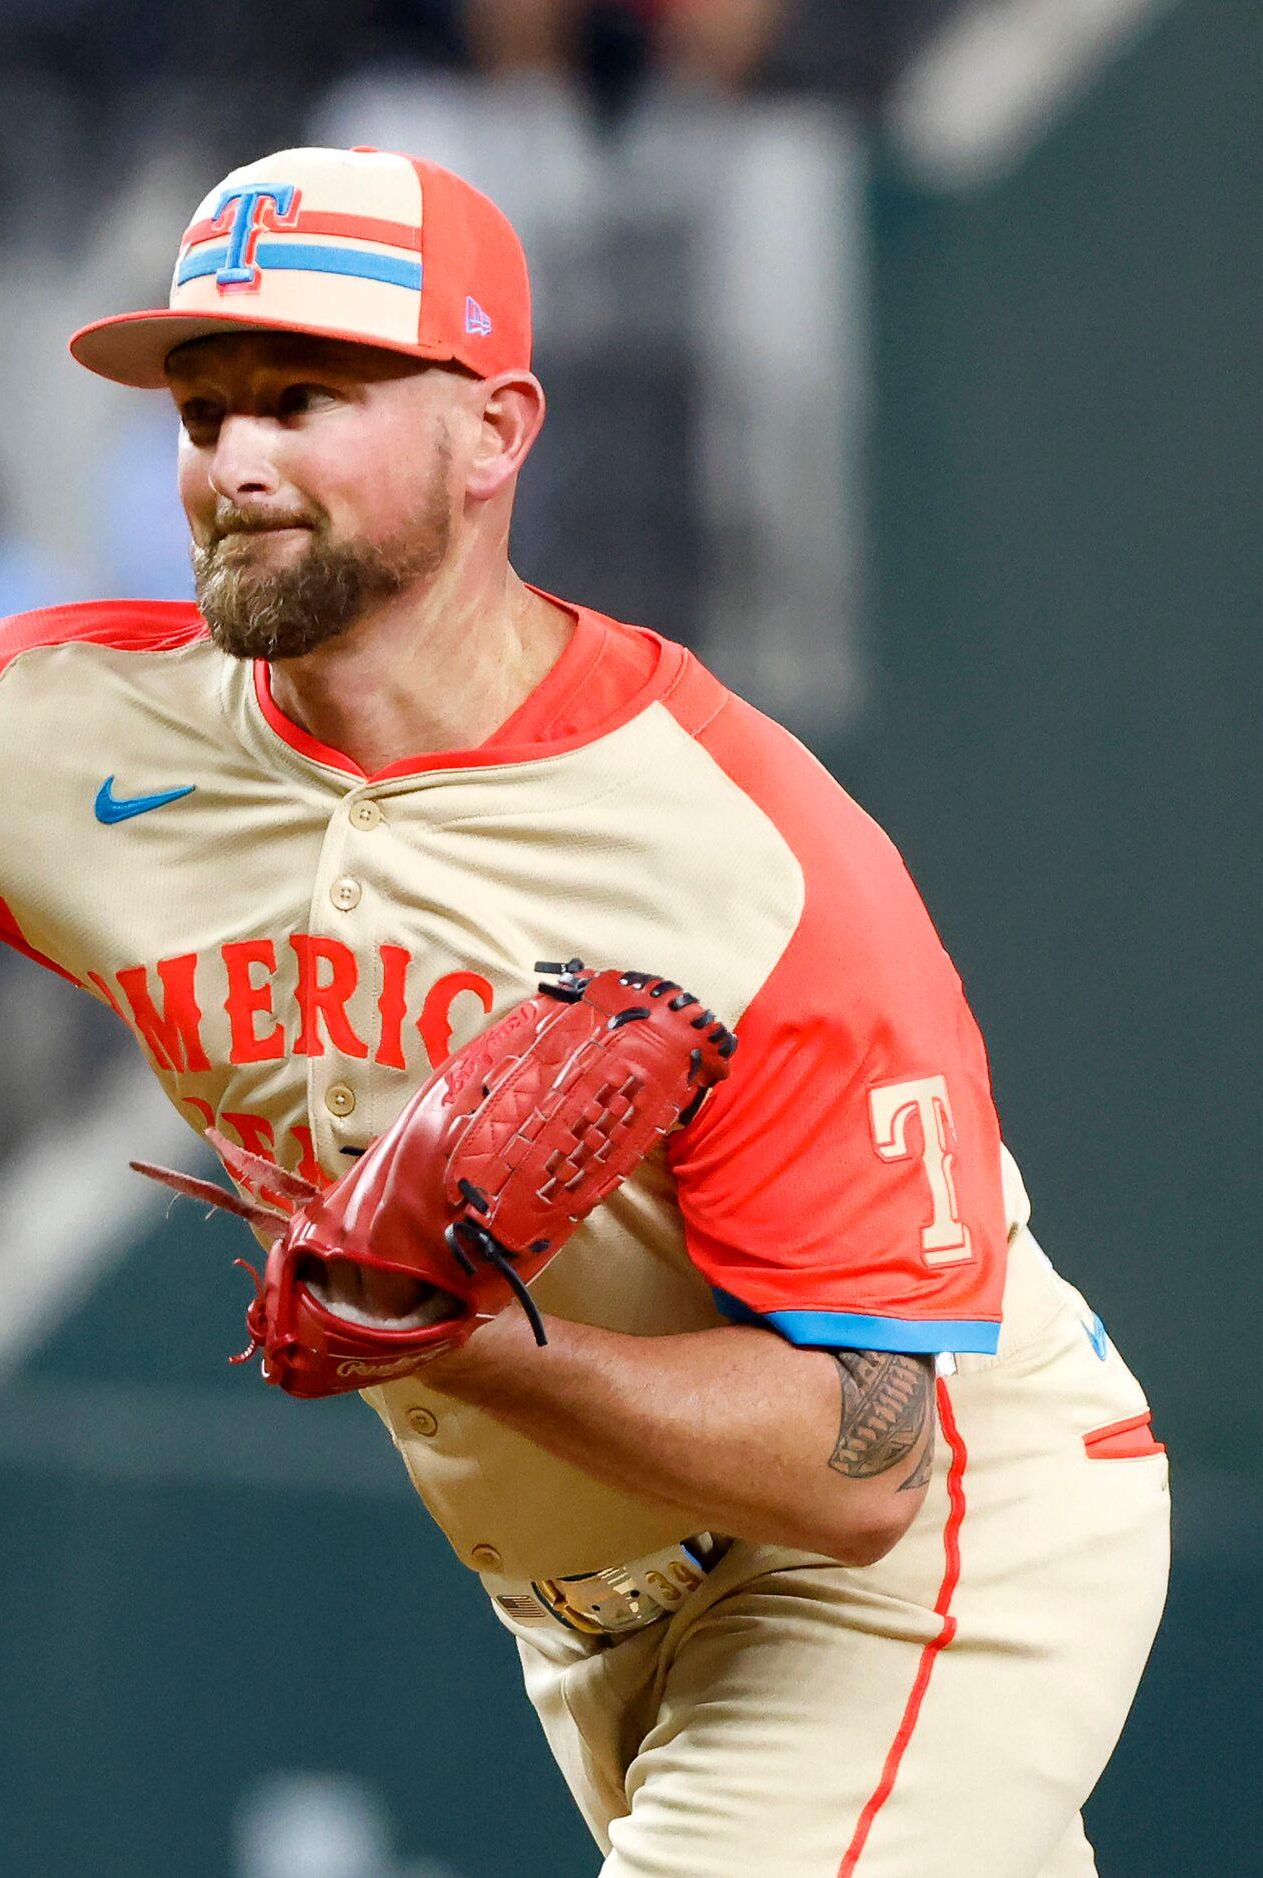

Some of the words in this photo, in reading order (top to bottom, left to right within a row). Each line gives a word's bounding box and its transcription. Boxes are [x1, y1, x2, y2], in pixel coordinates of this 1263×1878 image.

[211, 182, 302, 295] T
[87, 934, 494, 1073] MERIC
[868, 1074, 973, 1268] T
